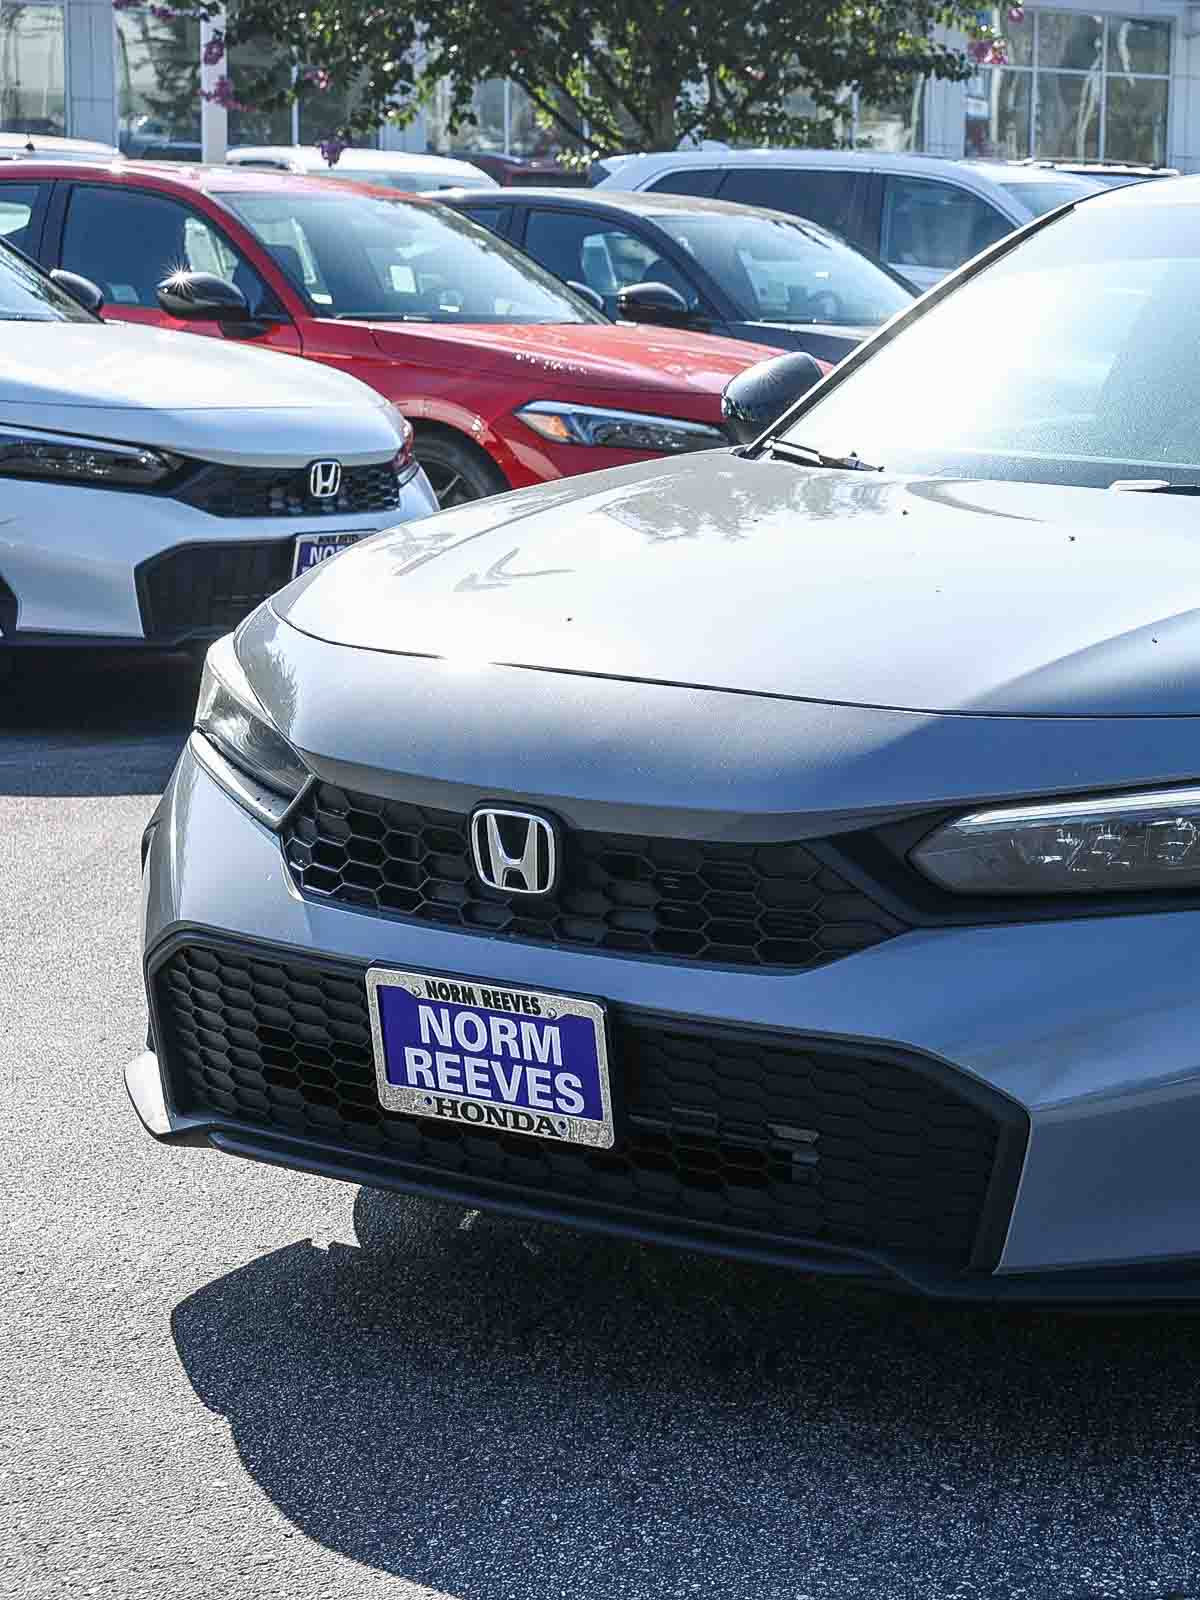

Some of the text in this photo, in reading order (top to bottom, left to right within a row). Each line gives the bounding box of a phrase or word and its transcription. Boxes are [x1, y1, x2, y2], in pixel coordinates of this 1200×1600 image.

[424, 979, 542, 1016] NORM REEVES
[418, 1004, 563, 1066] NORM
[404, 1046, 585, 1114] REEVES
[432, 1096, 561, 1137] HONDA
